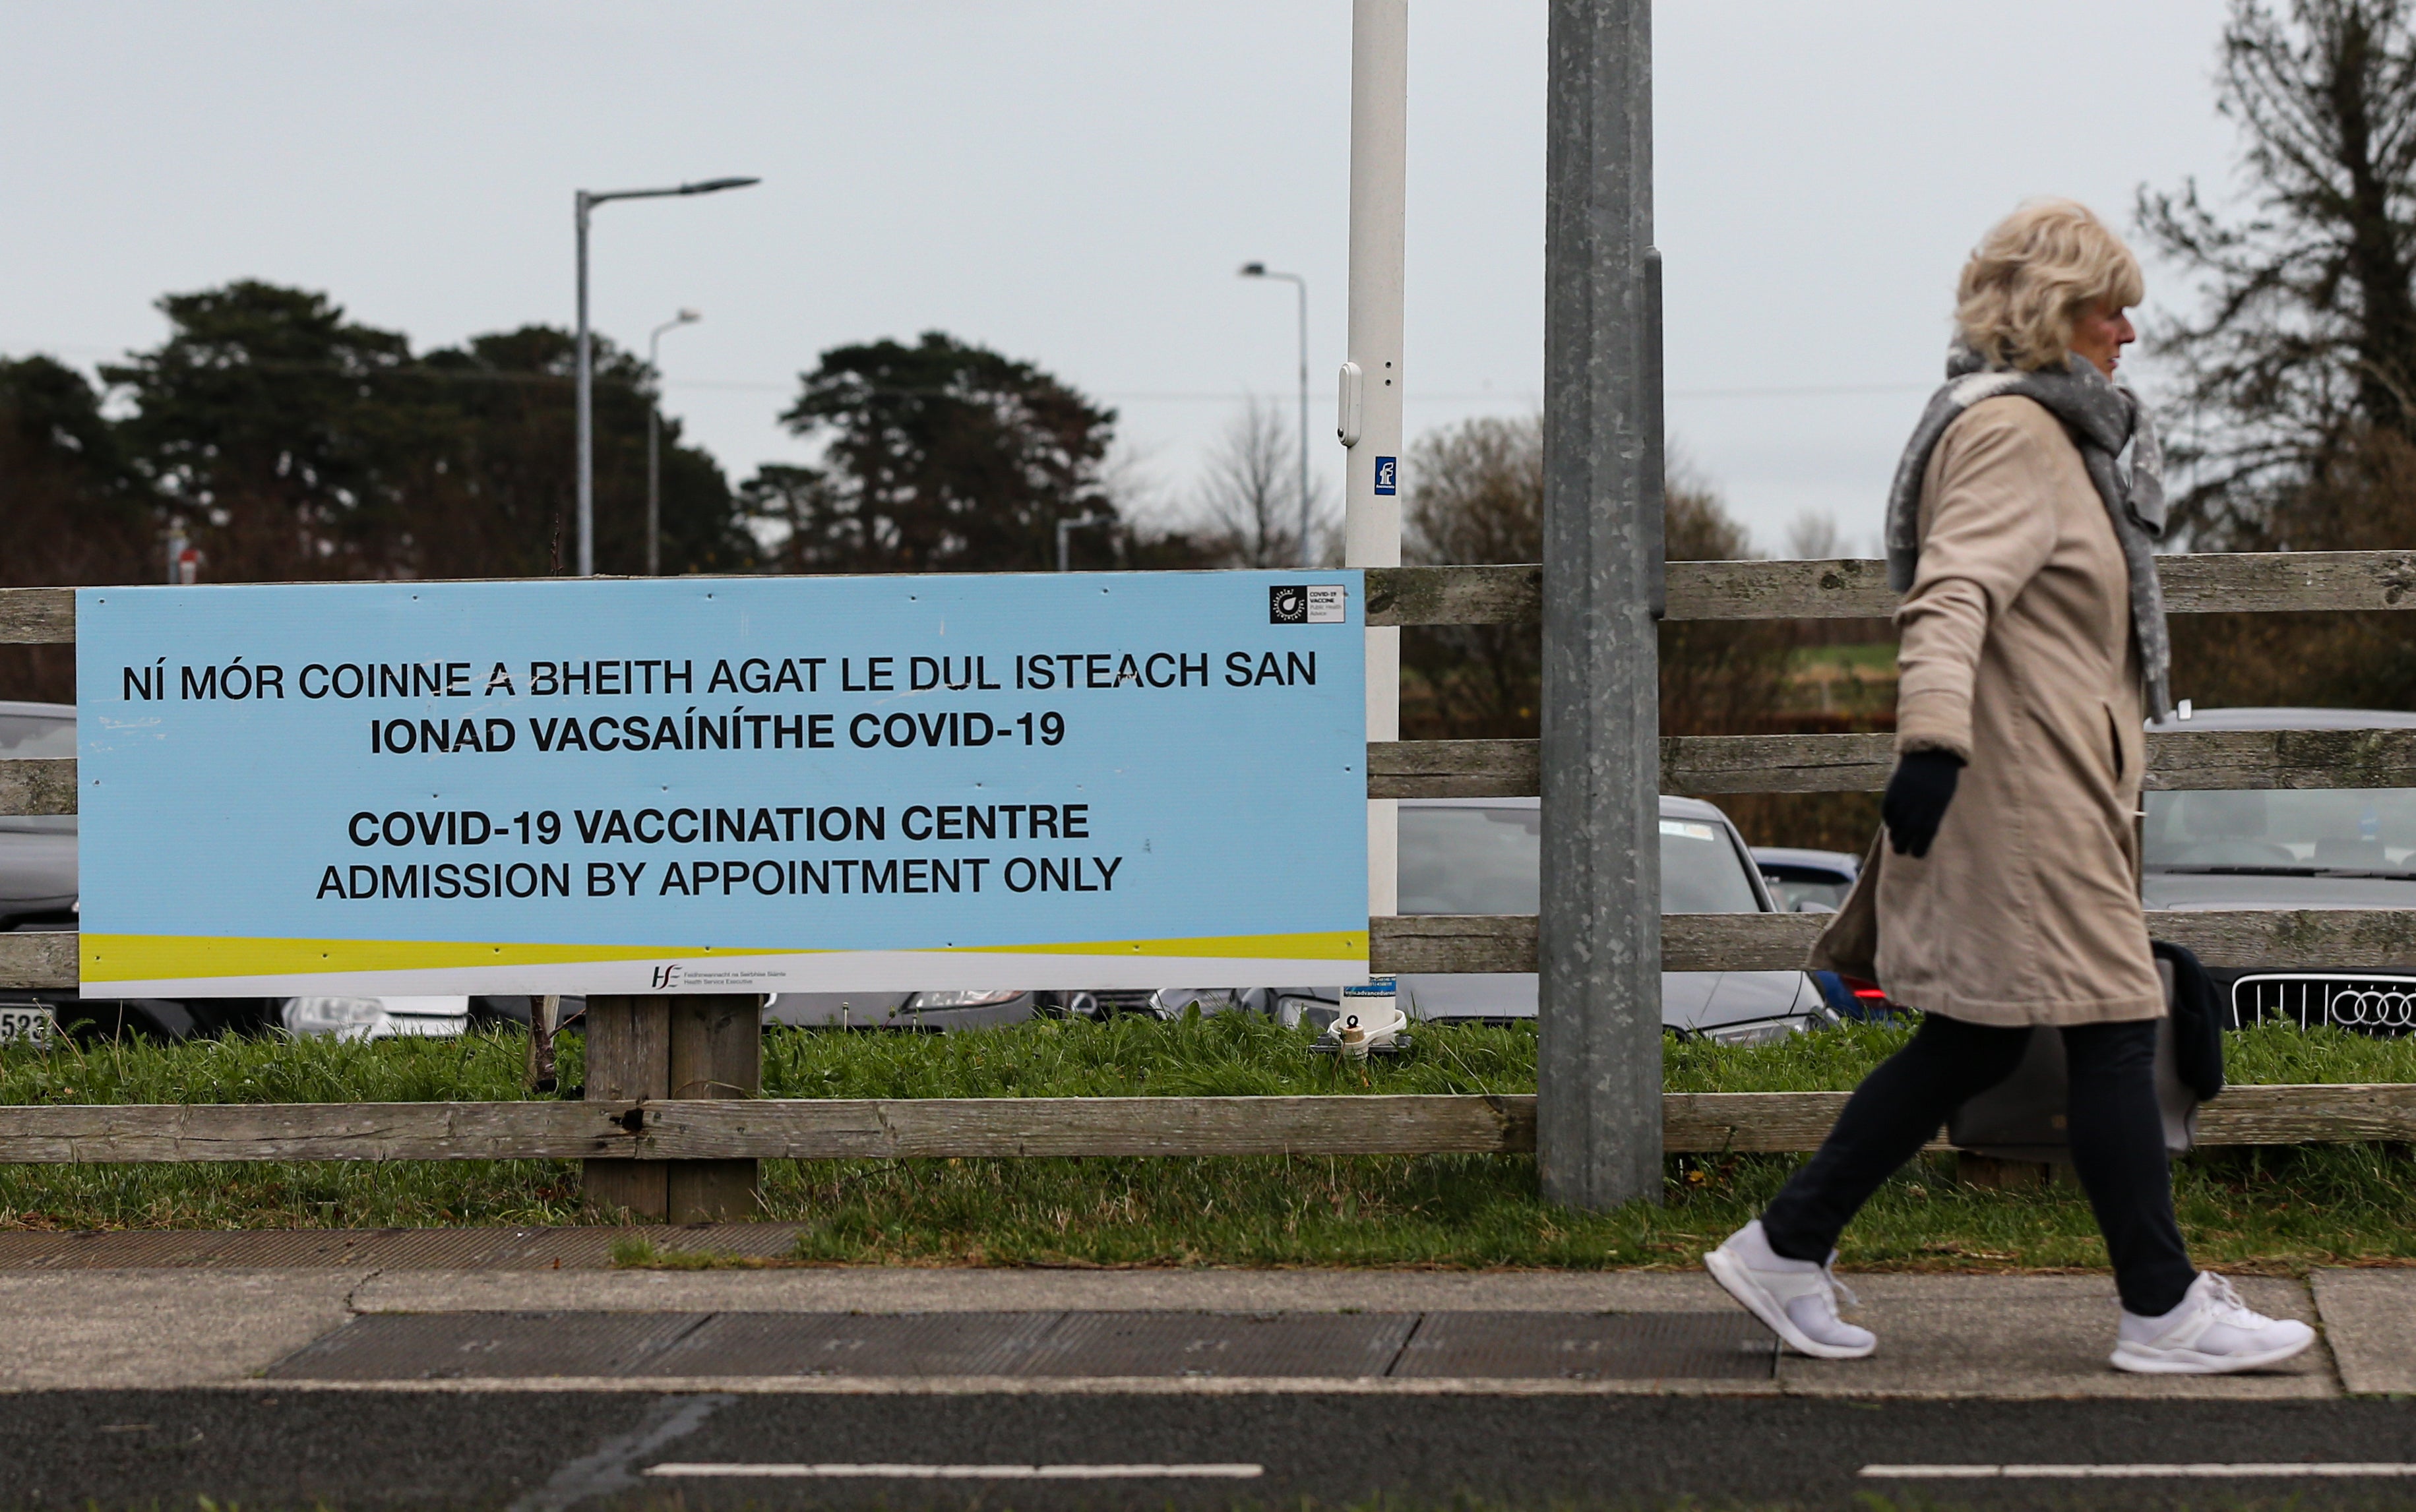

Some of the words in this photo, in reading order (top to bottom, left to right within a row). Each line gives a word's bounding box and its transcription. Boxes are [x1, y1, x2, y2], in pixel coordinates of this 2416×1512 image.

[123, 657, 166, 701] NÍ
[181, 656, 284, 700] MÓR
[299, 662, 472, 699] COINNE
[484, 661, 516, 696] A
[530, 659, 693, 696] BHEITH
[707, 657, 826, 694] AGAT
[842, 657, 894, 692] LE
[910, 655, 1001, 691] DUL
[1016, 652, 1209, 690] ISTEACH
[1225, 651, 1316, 687] SAN
[371, 718, 516, 754] IONAD
[529, 706, 835, 752] VACSAÍNÍTHE
[850, 711, 1065, 748] COVID-19
[348, 810, 562, 847] COVID-19
[573, 806, 886, 844] VACCINATION
[901, 804, 1090, 841] CENTRE
[316, 862, 570, 899] ADMISSION
[587, 862, 646, 897] BY
[659, 858, 991, 896] APPOINTMENT
[1004, 857, 1123, 893] ONLY
